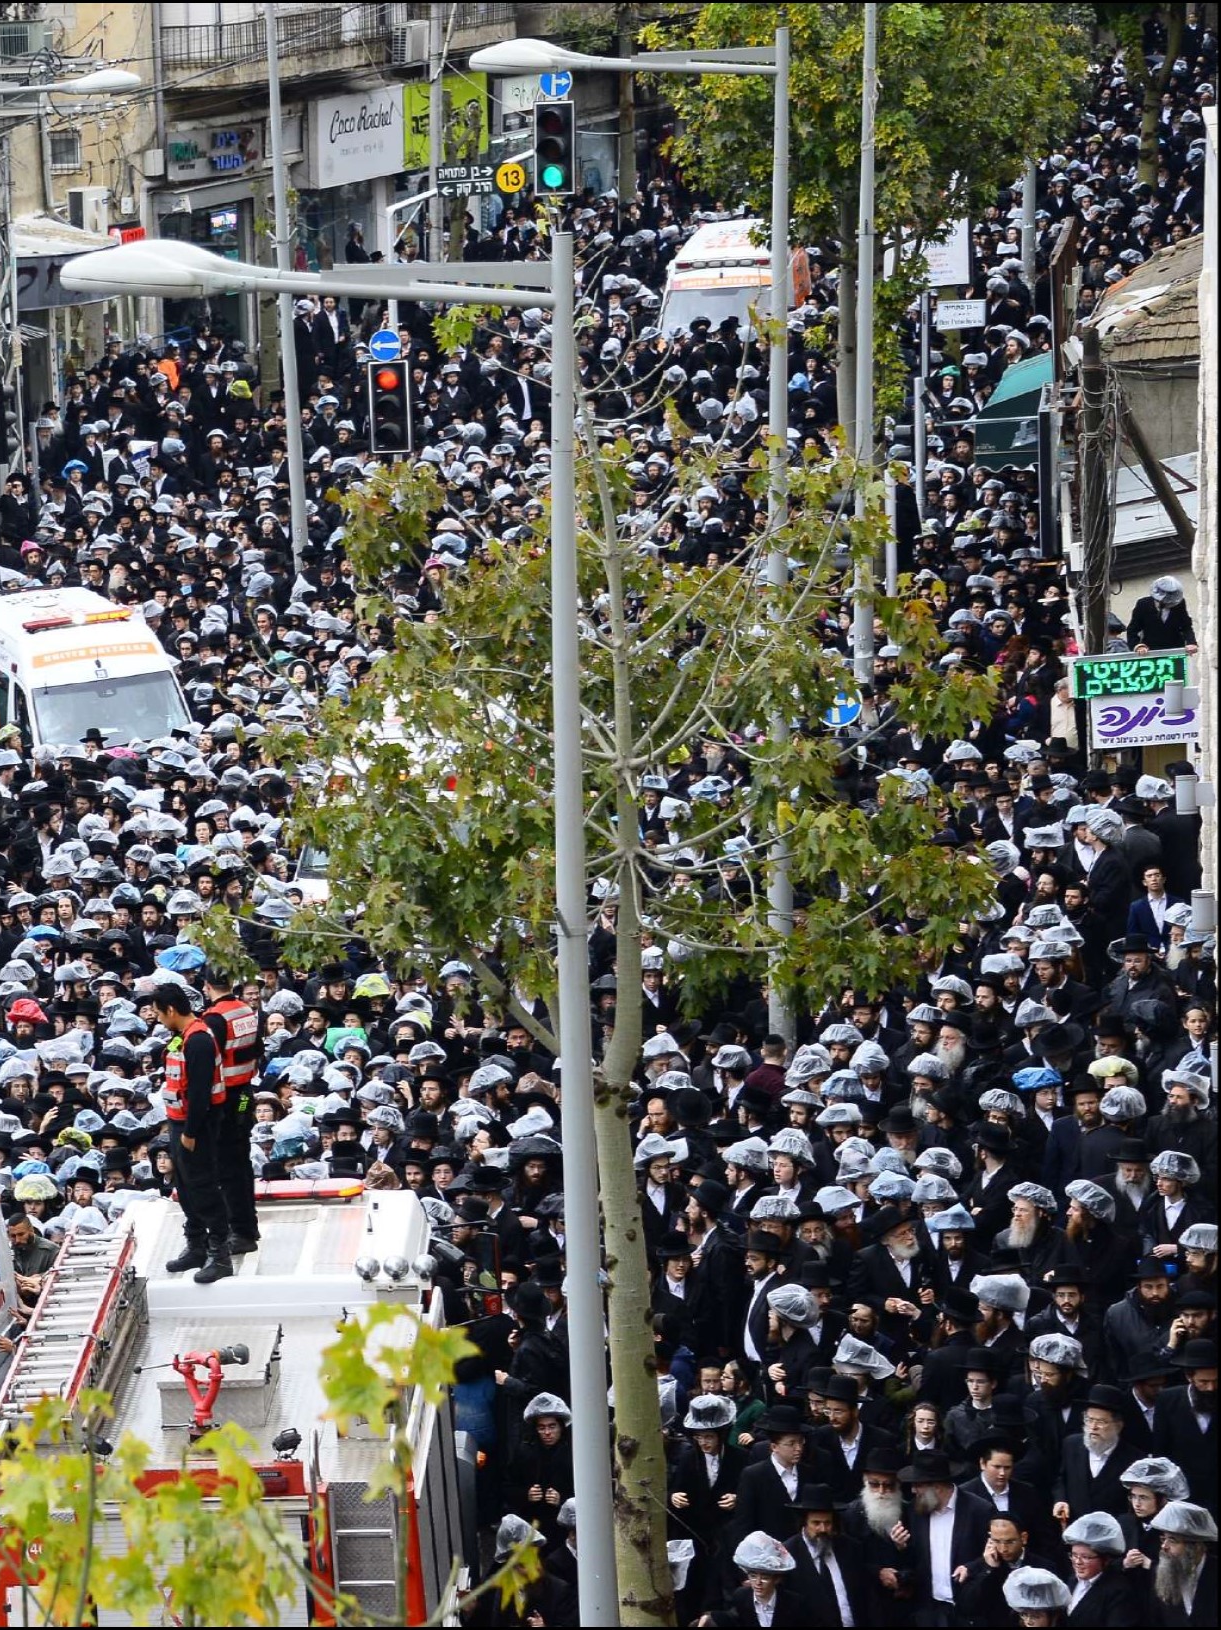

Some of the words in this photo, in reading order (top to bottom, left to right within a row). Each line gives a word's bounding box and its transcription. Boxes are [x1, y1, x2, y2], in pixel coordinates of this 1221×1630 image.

[330, 110, 356, 144] Coco
[357, 101, 394, 132] Rachel
[438, 167, 467, 179] פתחיה
[471, 166, 481, 179] בן
[503, 170, 521, 187] 13
[456, 183, 472, 197] קוק
[475, 181, 493, 193] הרב
[1083, 659, 1175, 679] תכשיטי
[1086, 675, 1174, 695] מעצבים
